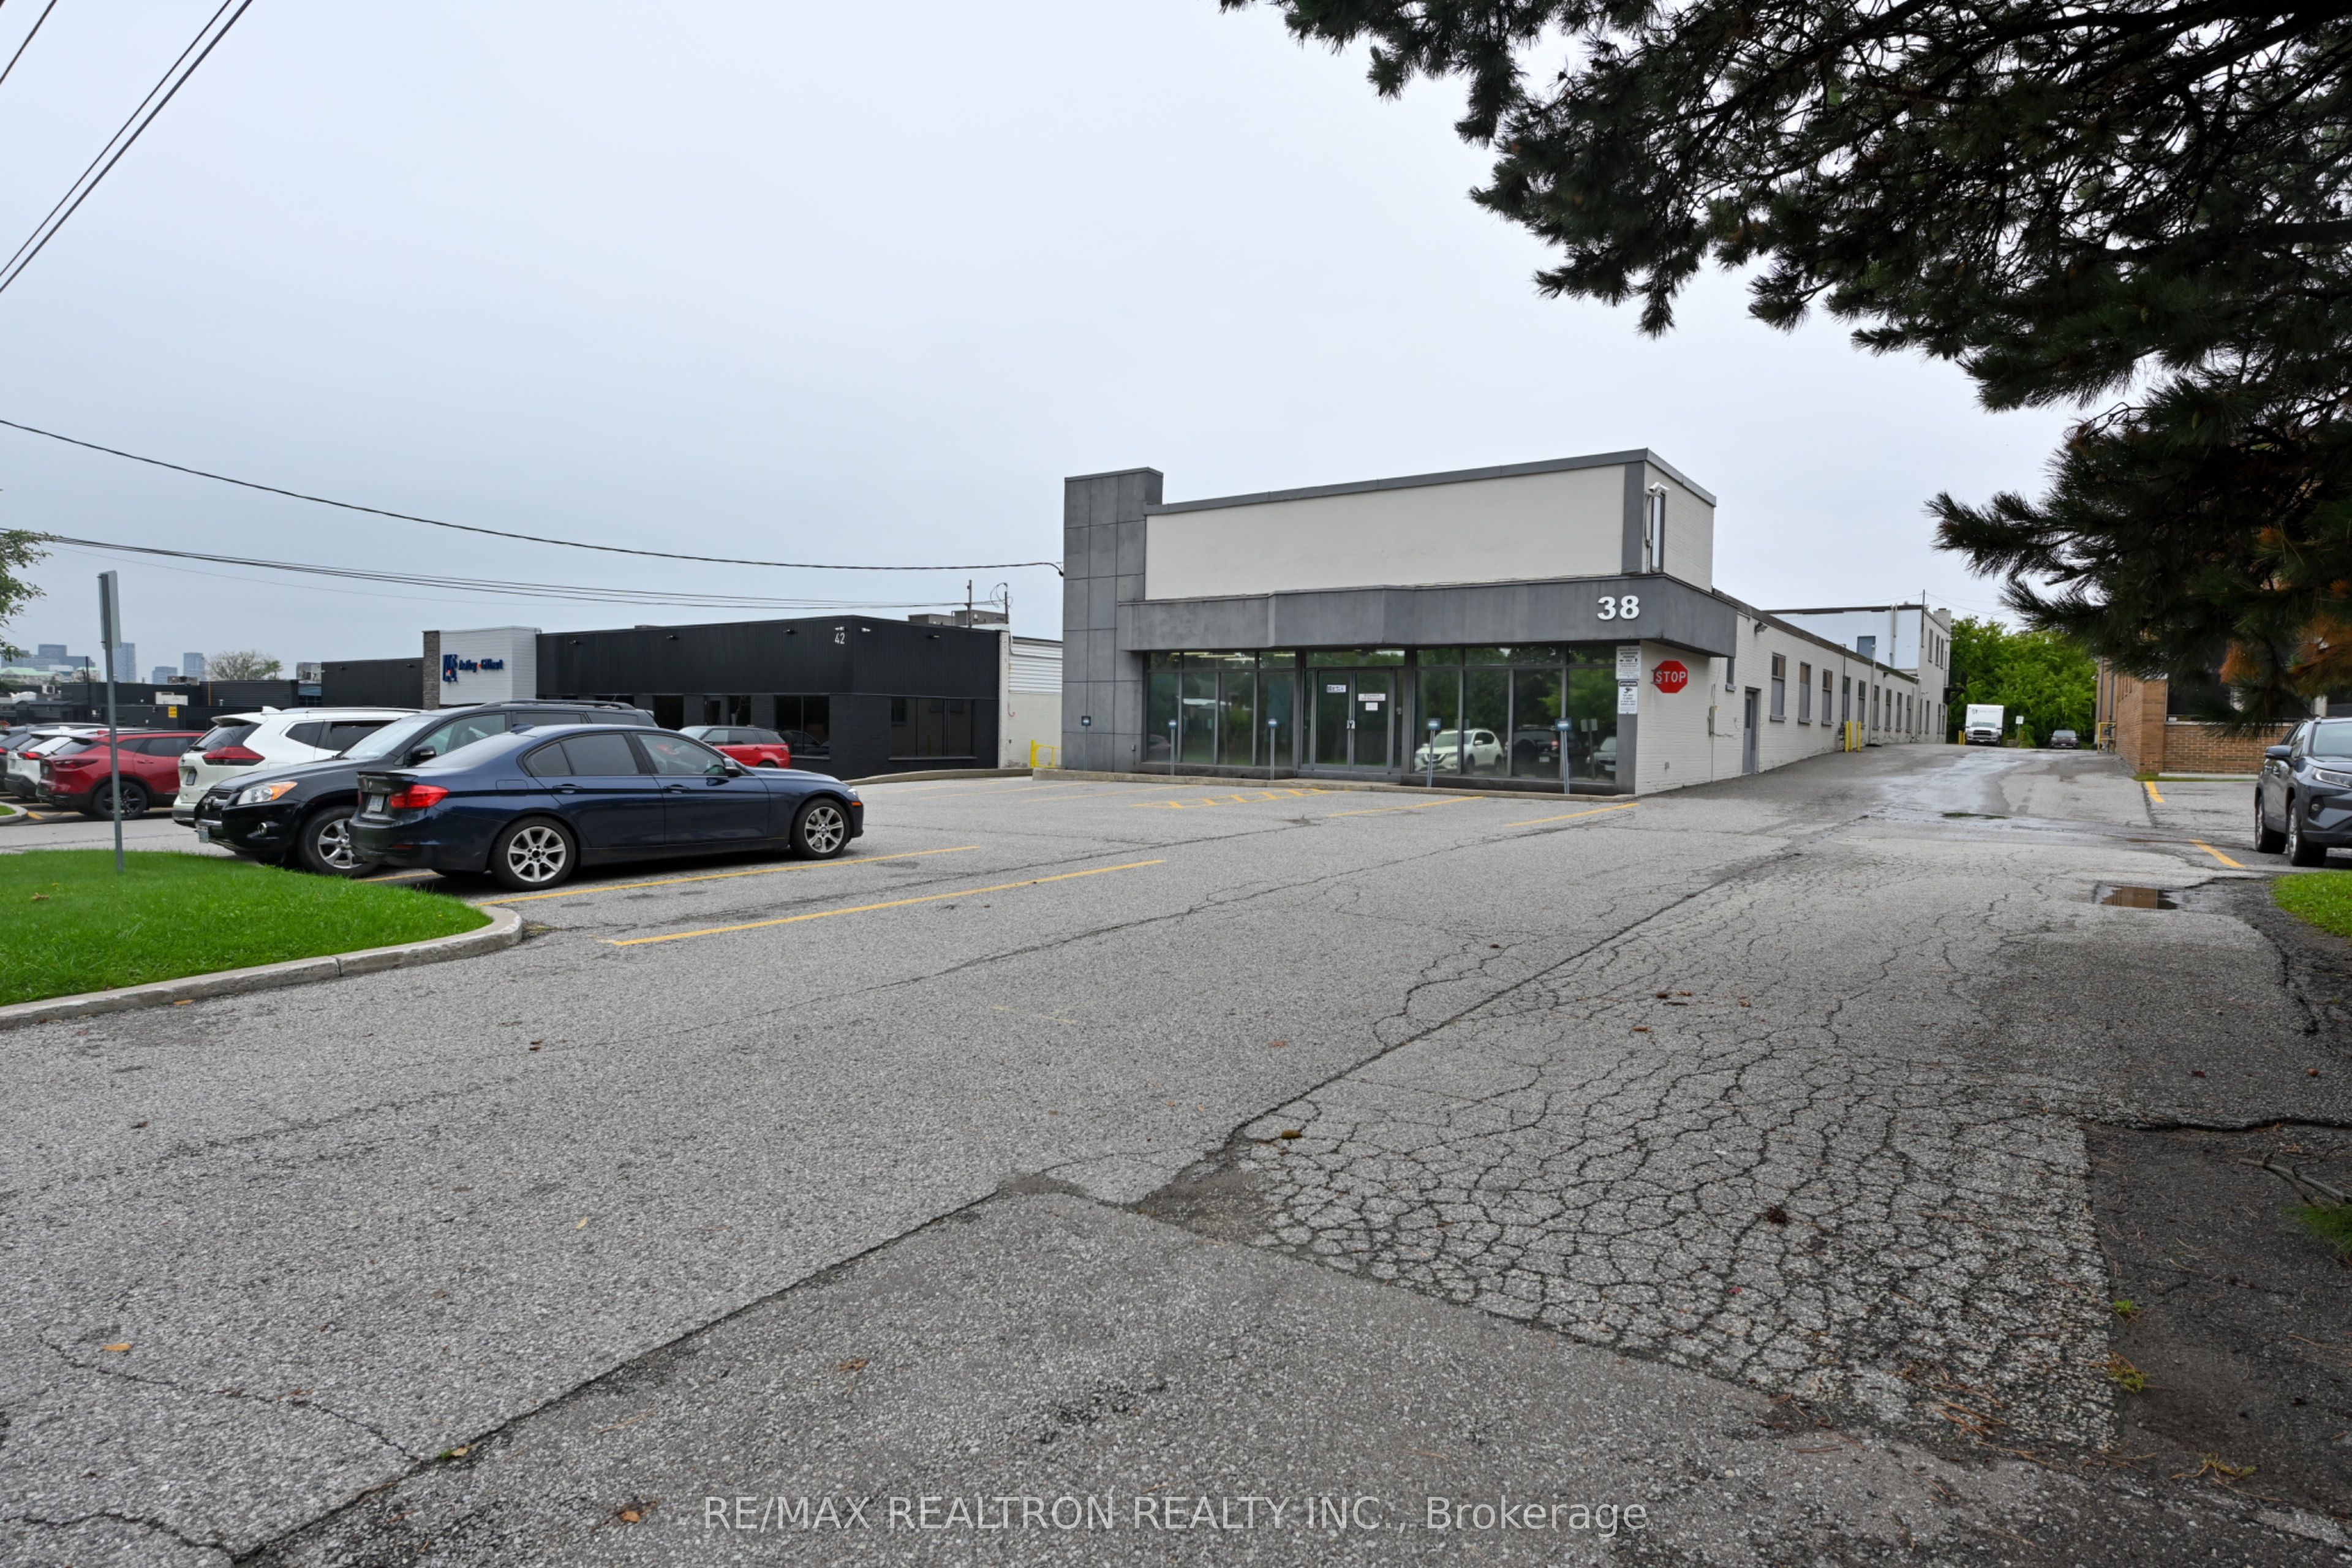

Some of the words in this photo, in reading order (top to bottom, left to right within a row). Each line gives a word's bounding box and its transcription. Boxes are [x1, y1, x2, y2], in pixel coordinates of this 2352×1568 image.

[1597, 595, 1640, 620] 38
[835, 632, 845, 644] 42
[1656, 671, 1686, 683] STOP
